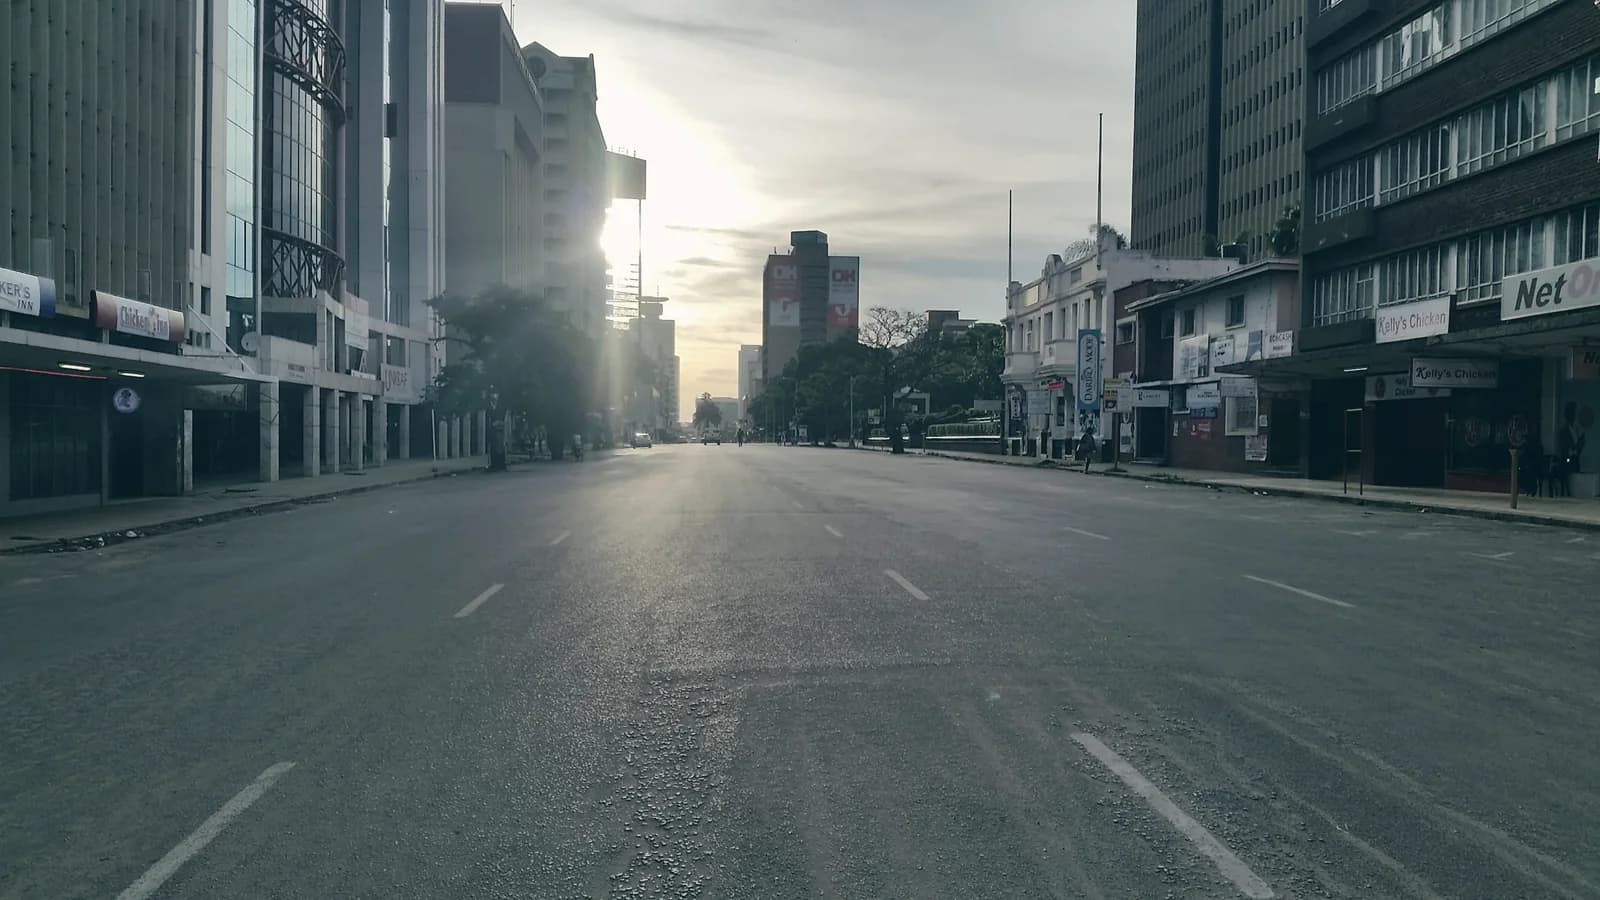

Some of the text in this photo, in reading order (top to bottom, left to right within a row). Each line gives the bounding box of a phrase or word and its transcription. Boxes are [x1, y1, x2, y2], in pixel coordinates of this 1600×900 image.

[17, 299, 34, 311] INN
[120, 305, 150, 332] Chicken
[1378, 312, 1446, 336] Kelly's Chicken
[1415, 367, 1496, 380] Kelly's Chicken
